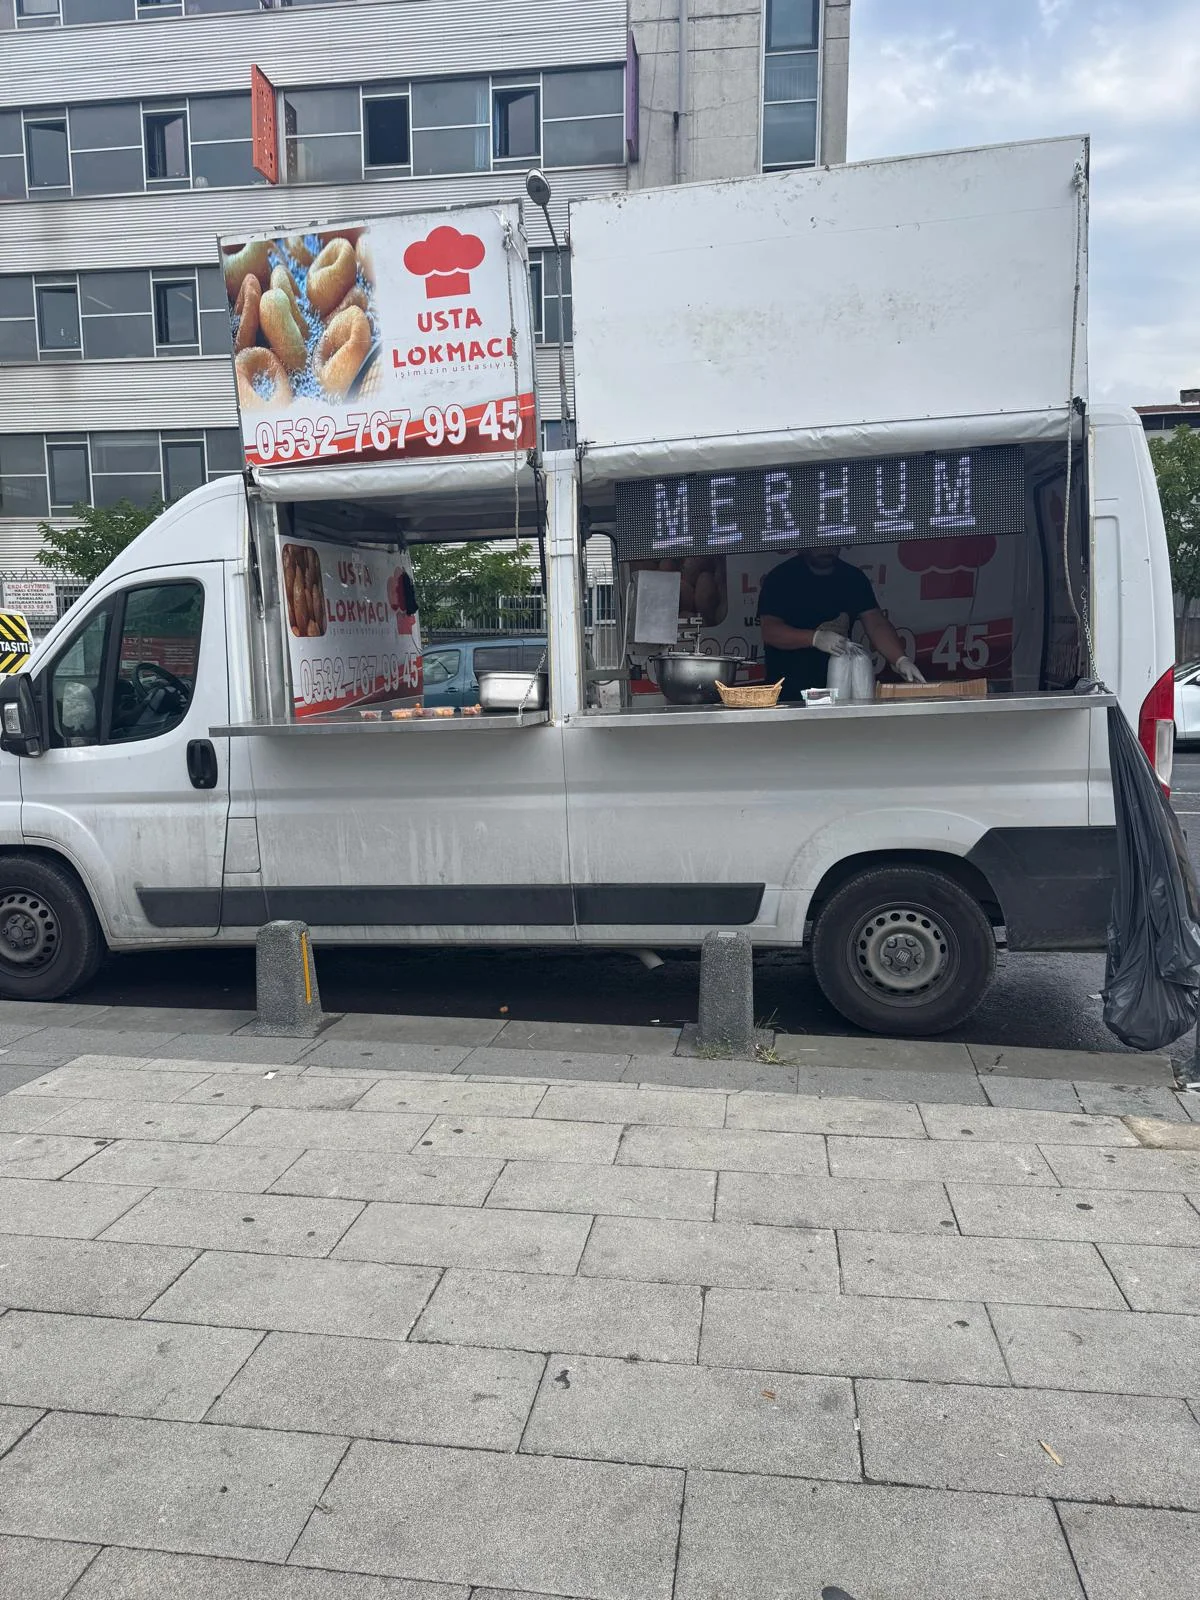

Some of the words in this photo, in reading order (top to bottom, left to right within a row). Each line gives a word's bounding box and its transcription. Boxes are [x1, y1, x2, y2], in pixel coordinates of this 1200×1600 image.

[417, 307, 482, 333] USTA
[392, 337, 513, 368] LOKMACI
[395, 366, 447, 379] işimizin
[255, 416, 338, 461] 0532
[347, 408, 411, 453] 767
[423, 403, 467, 447] 99
[478, 400, 523, 441] 45
[653, 456, 976, 548] MERHUM
[337, 561, 372, 586] USTA
[326, 598, 389, 624] LOKMACI
[0, 641, 28, 654] TAŞITI
[931, 623, 990, 672] 45
[300, 656, 346, 704] 0532
[348, 655, 377, 696] 767
[381, 653, 399, 692] 99
[402, 652, 418, 688] 45
